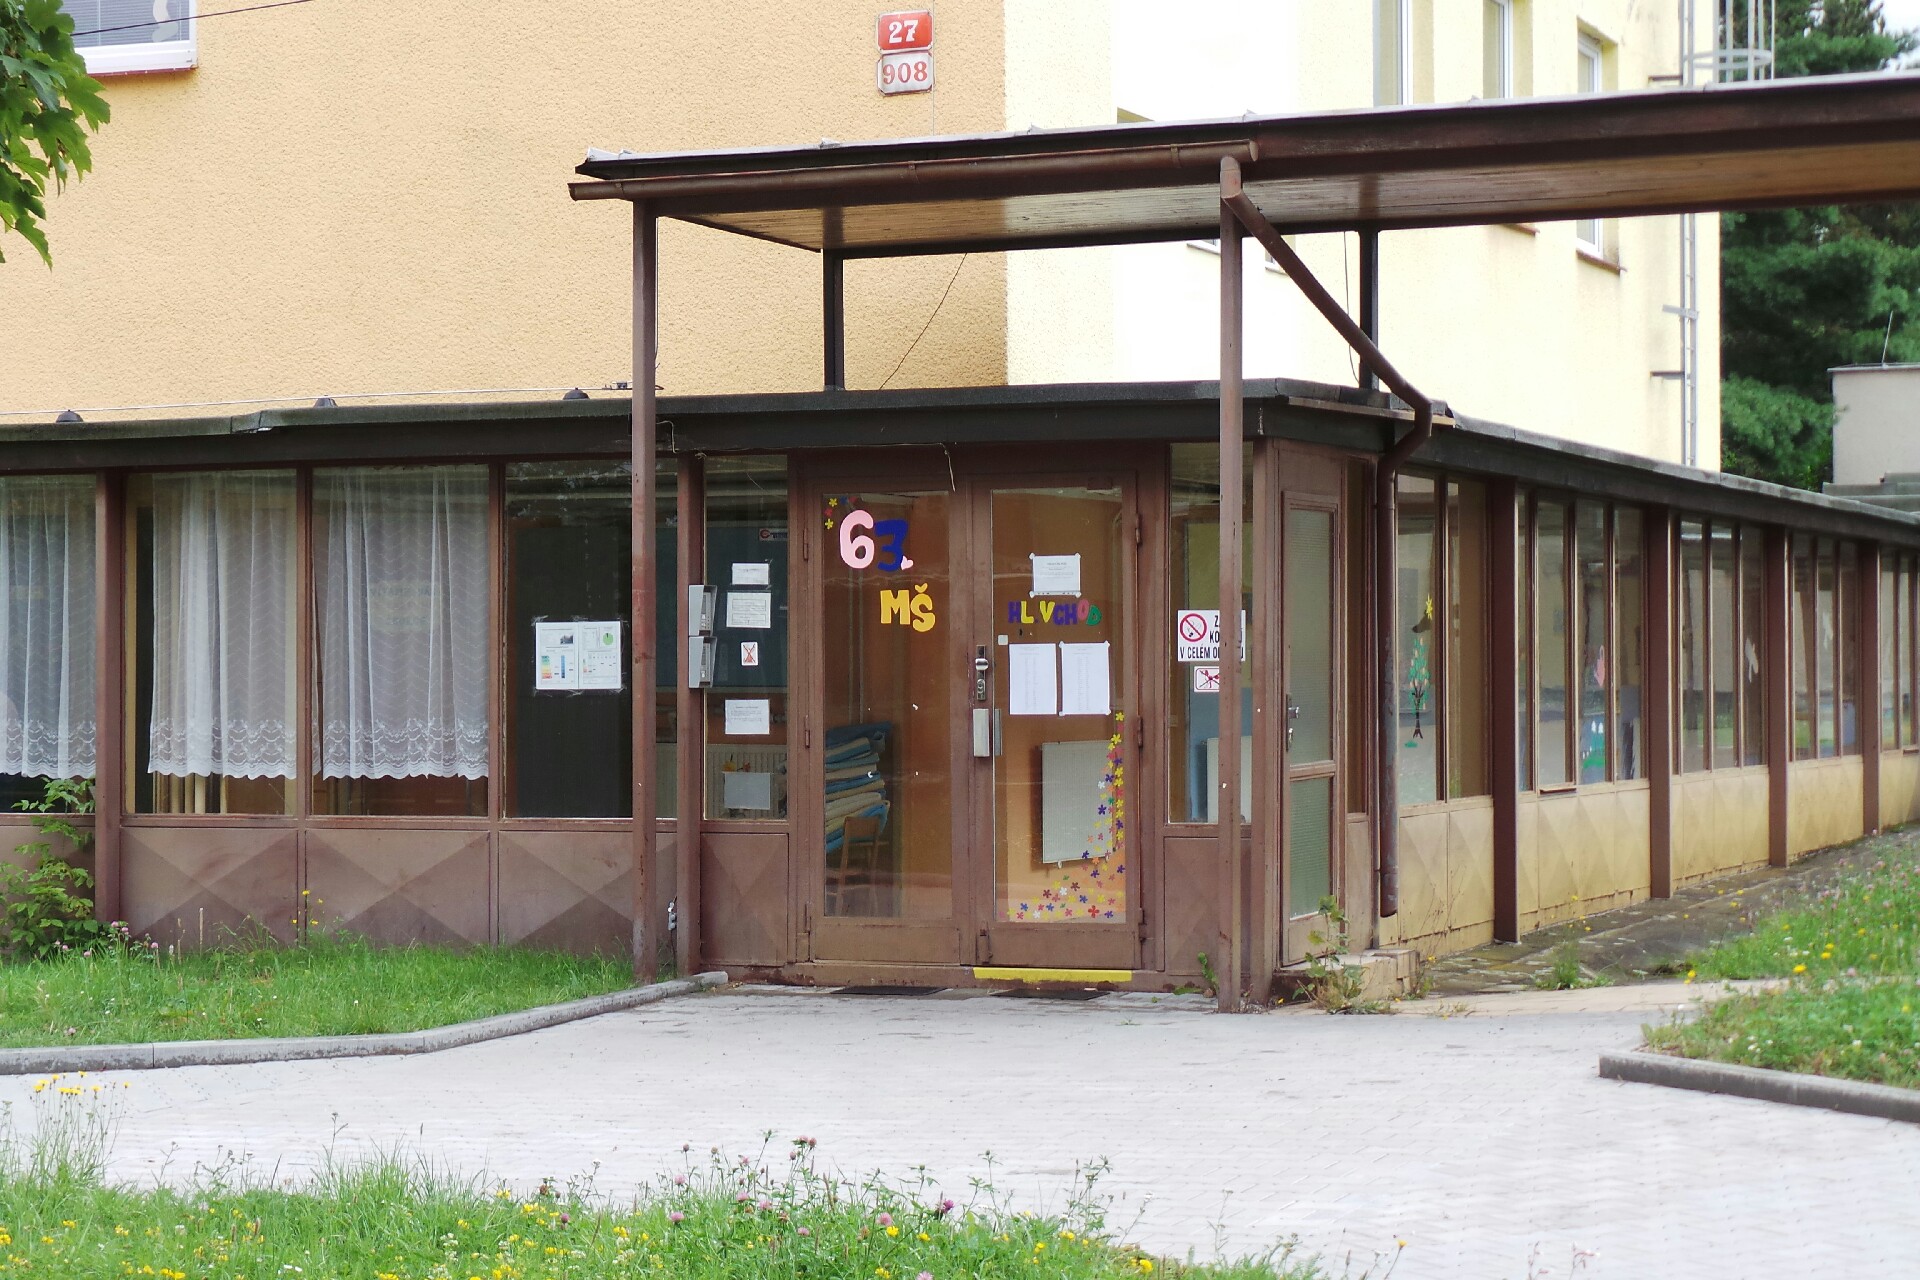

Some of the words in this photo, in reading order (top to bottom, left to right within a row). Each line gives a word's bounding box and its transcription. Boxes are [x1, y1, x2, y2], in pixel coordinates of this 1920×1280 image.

[889, 20, 918, 43] 27
[883, 61, 928, 84] 908
[880, 582, 936, 632] MŠ
[1039, 599, 1102, 627] VCHOD
[1180, 646, 1185, 659] V
[1187, 644, 1211, 659] CELÉM
